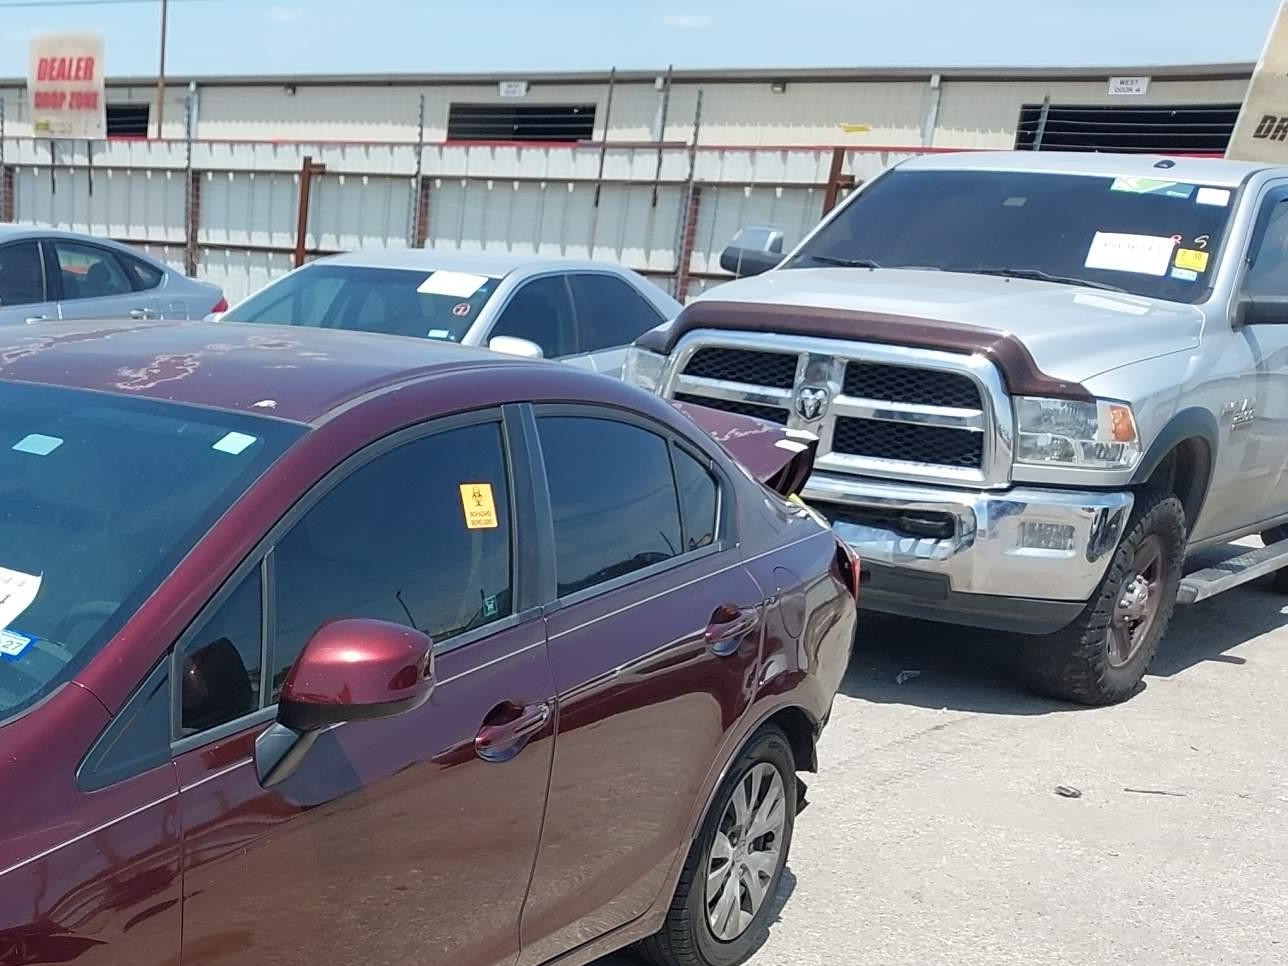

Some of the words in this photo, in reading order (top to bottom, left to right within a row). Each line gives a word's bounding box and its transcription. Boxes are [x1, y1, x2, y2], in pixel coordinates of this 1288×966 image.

[37, 56, 95, 81] DEALER
[34, 91, 66, 109] DROP
[69, 91, 98, 110] ZONE
